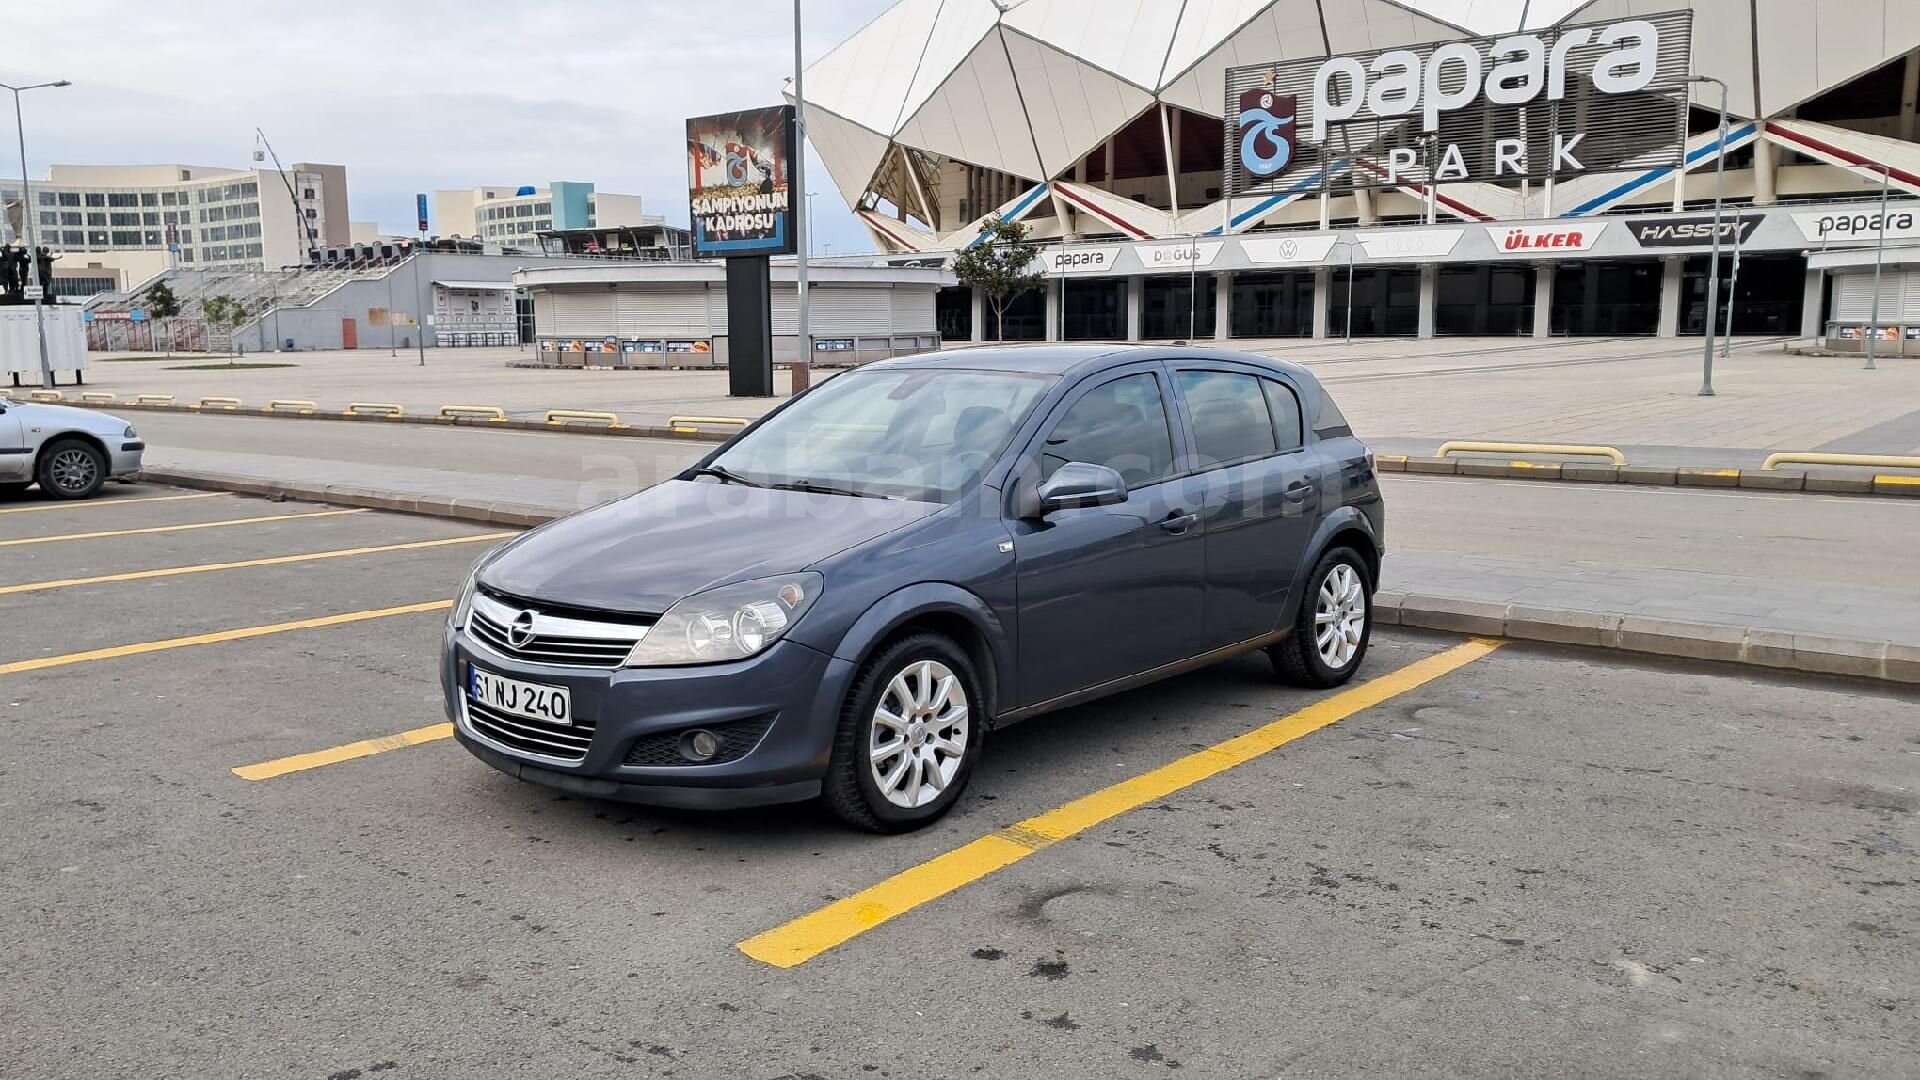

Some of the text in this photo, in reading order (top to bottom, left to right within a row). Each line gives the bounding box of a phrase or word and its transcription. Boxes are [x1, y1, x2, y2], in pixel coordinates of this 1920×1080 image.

[1312, 20, 1658, 141] papara
[1389, 133, 1586, 183] PARK
[705, 213, 774, 232] KADROSU
[1640, 221, 1750, 240] HASSOY
[1818, 213, 1913, 236] papara
[1504, 229, 1583, 250] ÜLKER
[1055, 251, 1104, 268] papara
[495, 680, 517, 709] NJ
[523, 687, 566, 720] 240
